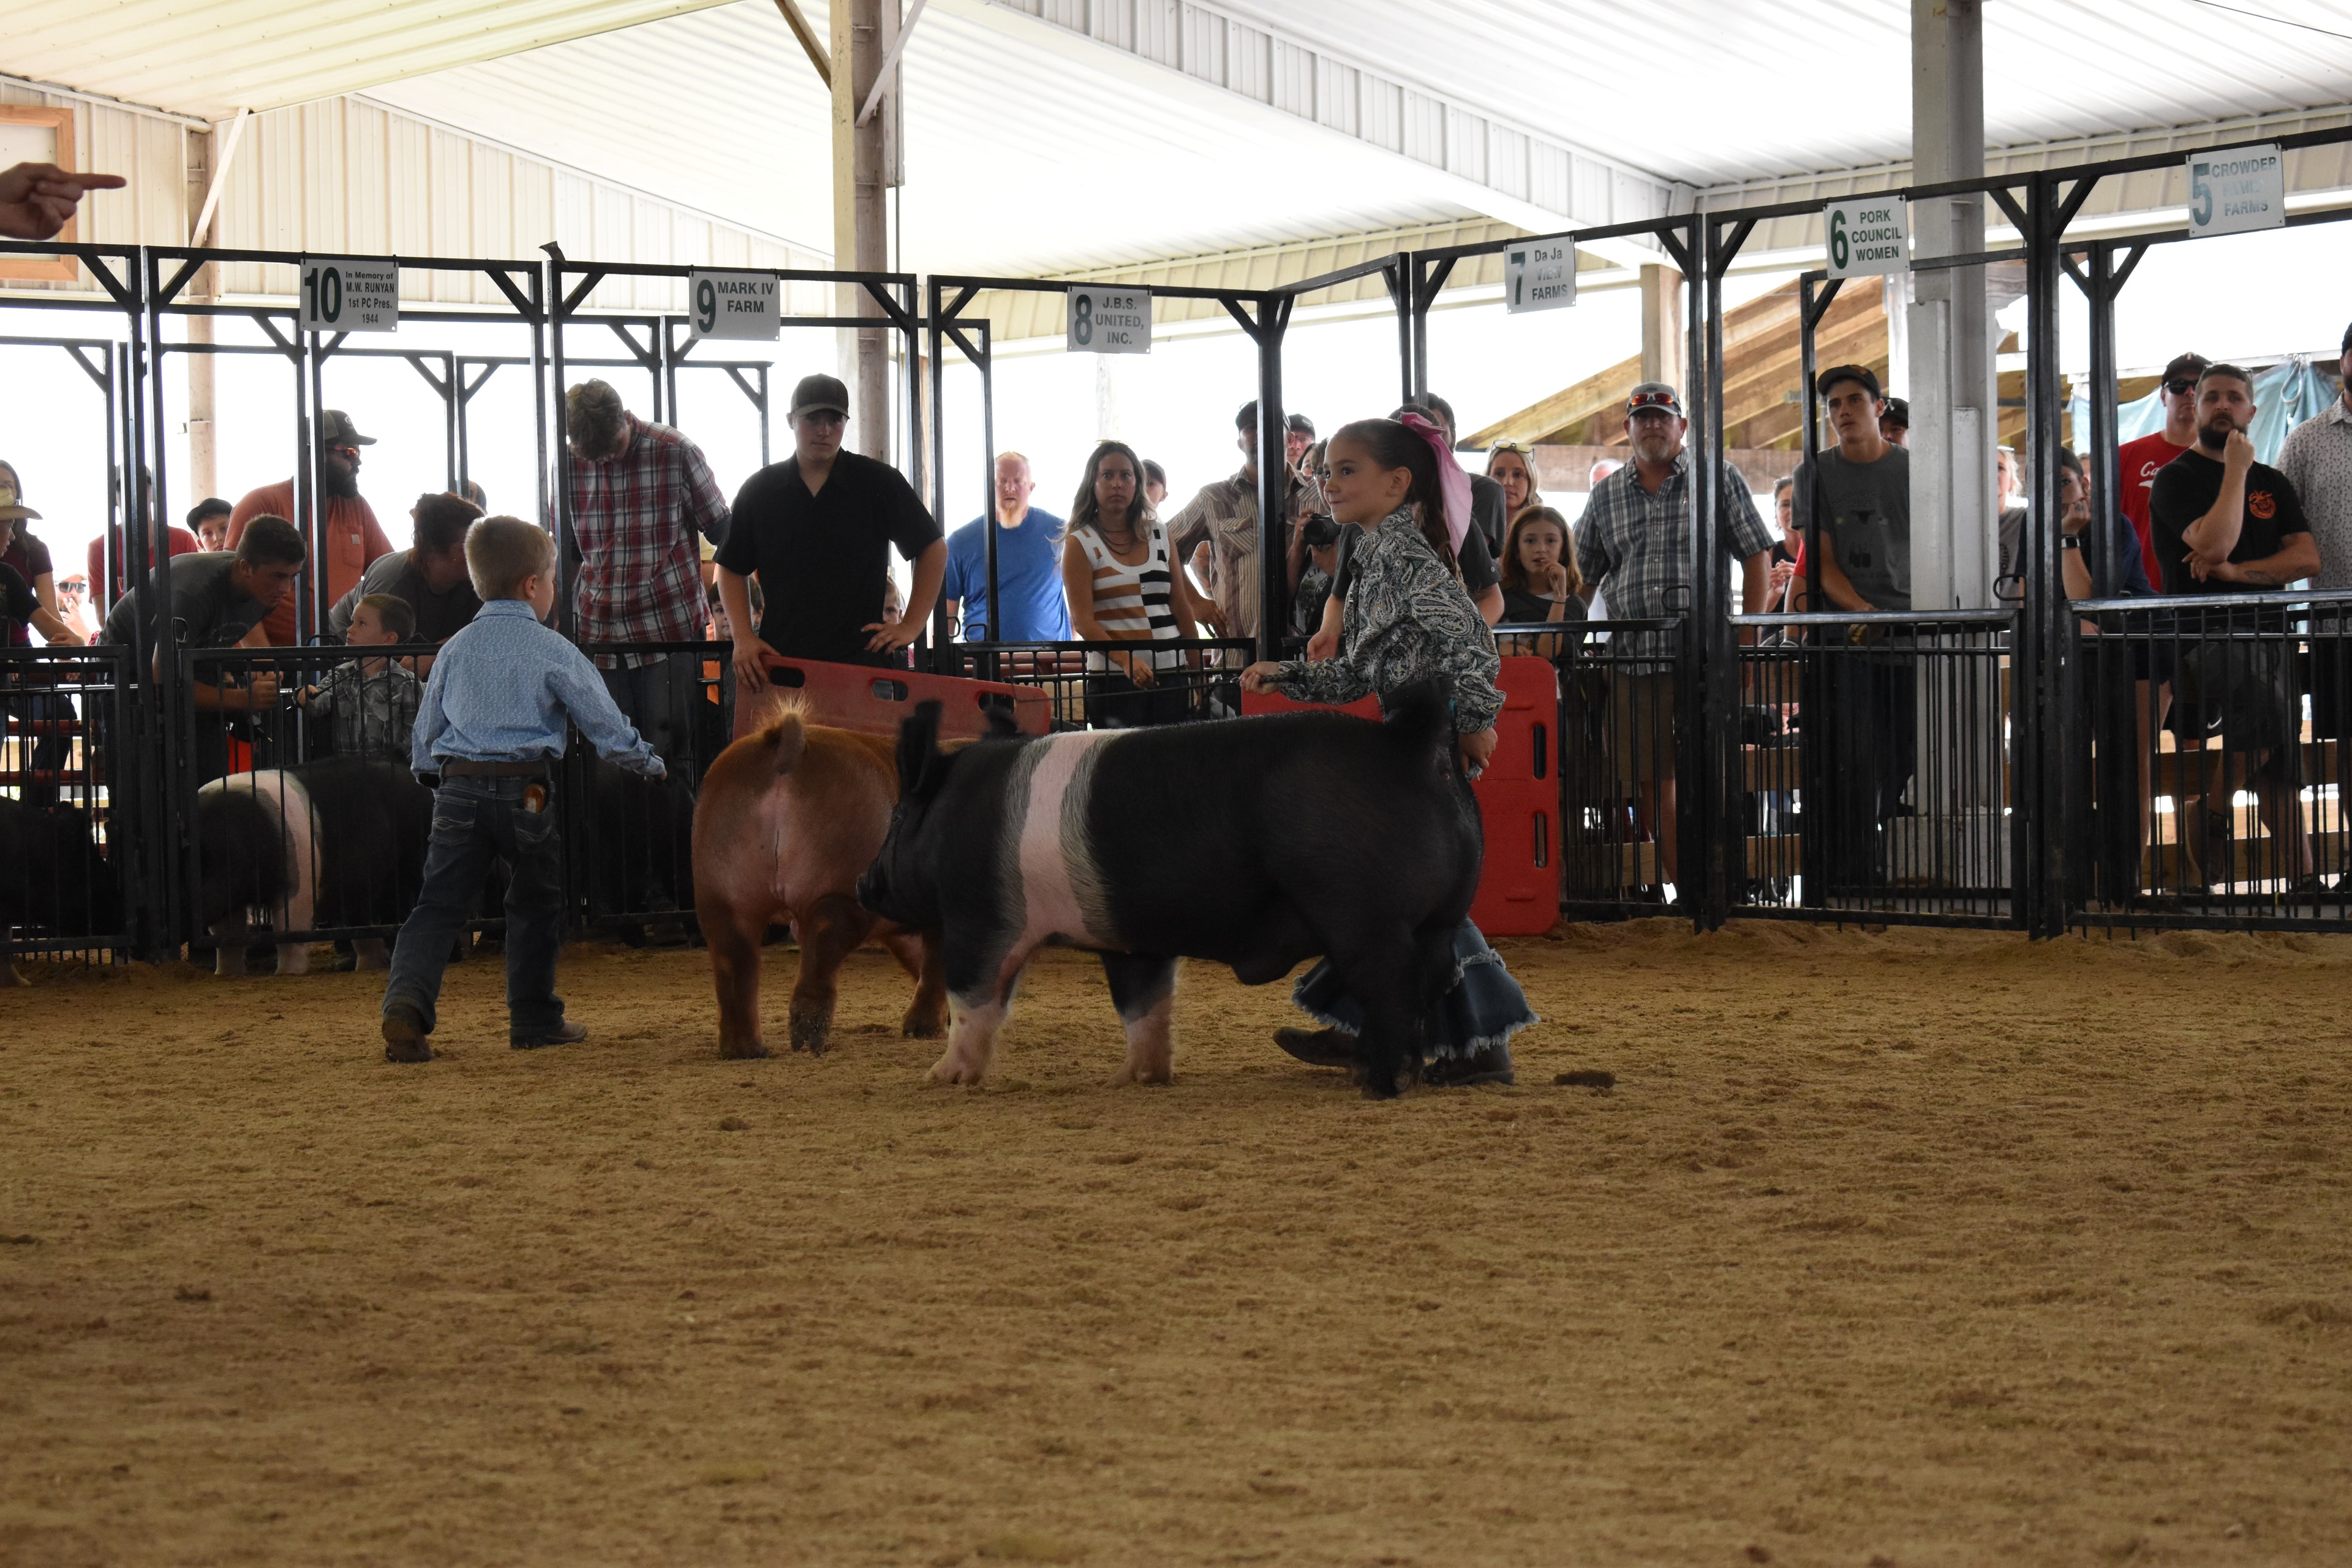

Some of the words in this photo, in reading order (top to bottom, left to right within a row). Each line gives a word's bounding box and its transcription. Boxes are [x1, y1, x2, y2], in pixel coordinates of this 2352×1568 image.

[2212, 156, 2277, 178] CROWDER
[2192, 162, 2212, 227] 5
[2225, 200, 2269, 216] FARMS
[1860, 209, 1891, 224] PORK
[1830, 209, 1849, 270] 6
[1852, 227, 1902, 243] COUNCIL
[1534, 249, 1547, 262] Da
[1550, 247, 1562, 260] Ja
[1856, 246, 1899, 262] WOMEN
[355, 271, 384, 281] Memory
[1510, 251, 1526, 305] 7
[304, 266, 342, 323] 10
[346, 282, 363, 293] M.W.
[365, 282, 394, 293] RUNYAN
[718, 282, 756, 294] MARK
[761, 283, 774, 295] IV
[1532, 284, 1567, 301] FARMS
[349, 298, 360, 308] 1st
[361, 298, 371, 308] PC
[374, 298, 392, 308] Pres.
[696, 279, 716, 333] 9
[728, 300, 764, 313] FARM
[1102, 297, 1137, 310] J.B.S.
[362, 314, 379, 323] 1944
[1074, 294, 1092, 345] 8
[1096, 314, 1144, 330] UNITED,
[1107, 332, 1132, 344] INC.
